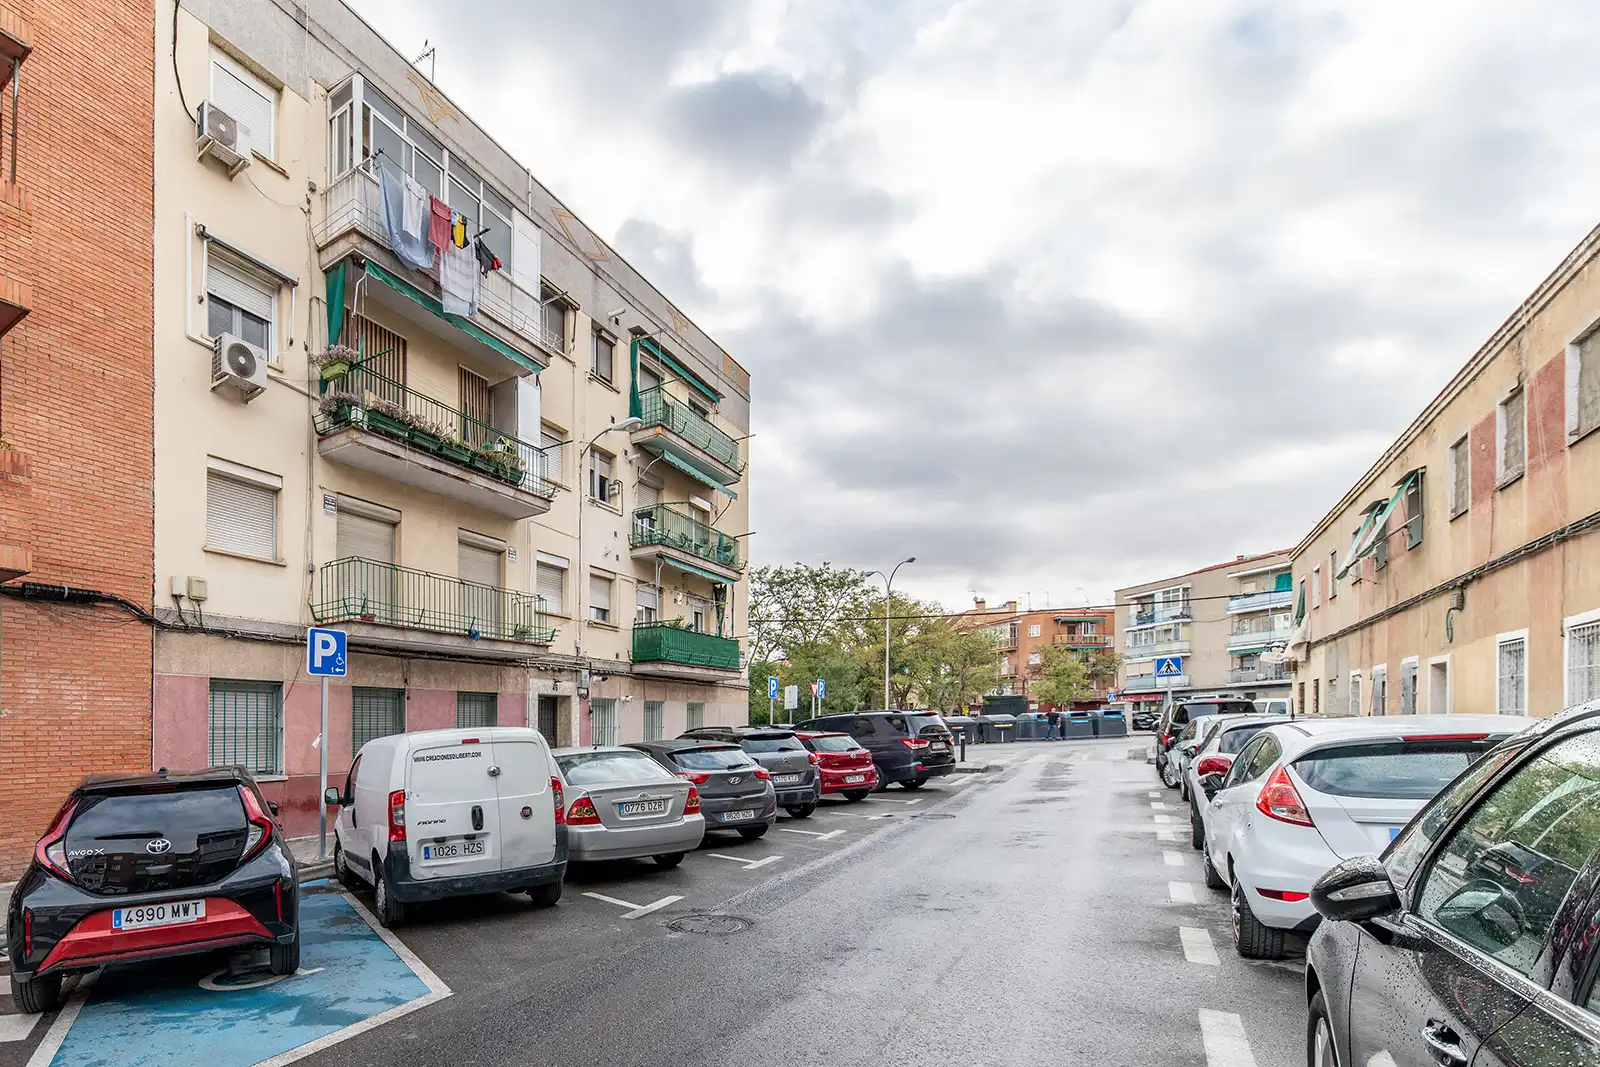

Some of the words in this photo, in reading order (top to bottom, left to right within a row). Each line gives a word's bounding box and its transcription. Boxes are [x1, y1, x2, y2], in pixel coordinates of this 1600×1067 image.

[314, 632, 337, 667] P
[770, 679, 777, 696] P
[819, 681, 824, 696] P
[624, 803, 645, 814] 0776
[647, 801, 663, 811] DZR
[433, 845, 457, 857] 1026
[463, 842, 483, 854] HZS
[125, 906, 165, 924] 4990
[171, 901, 200, 918] MWT
